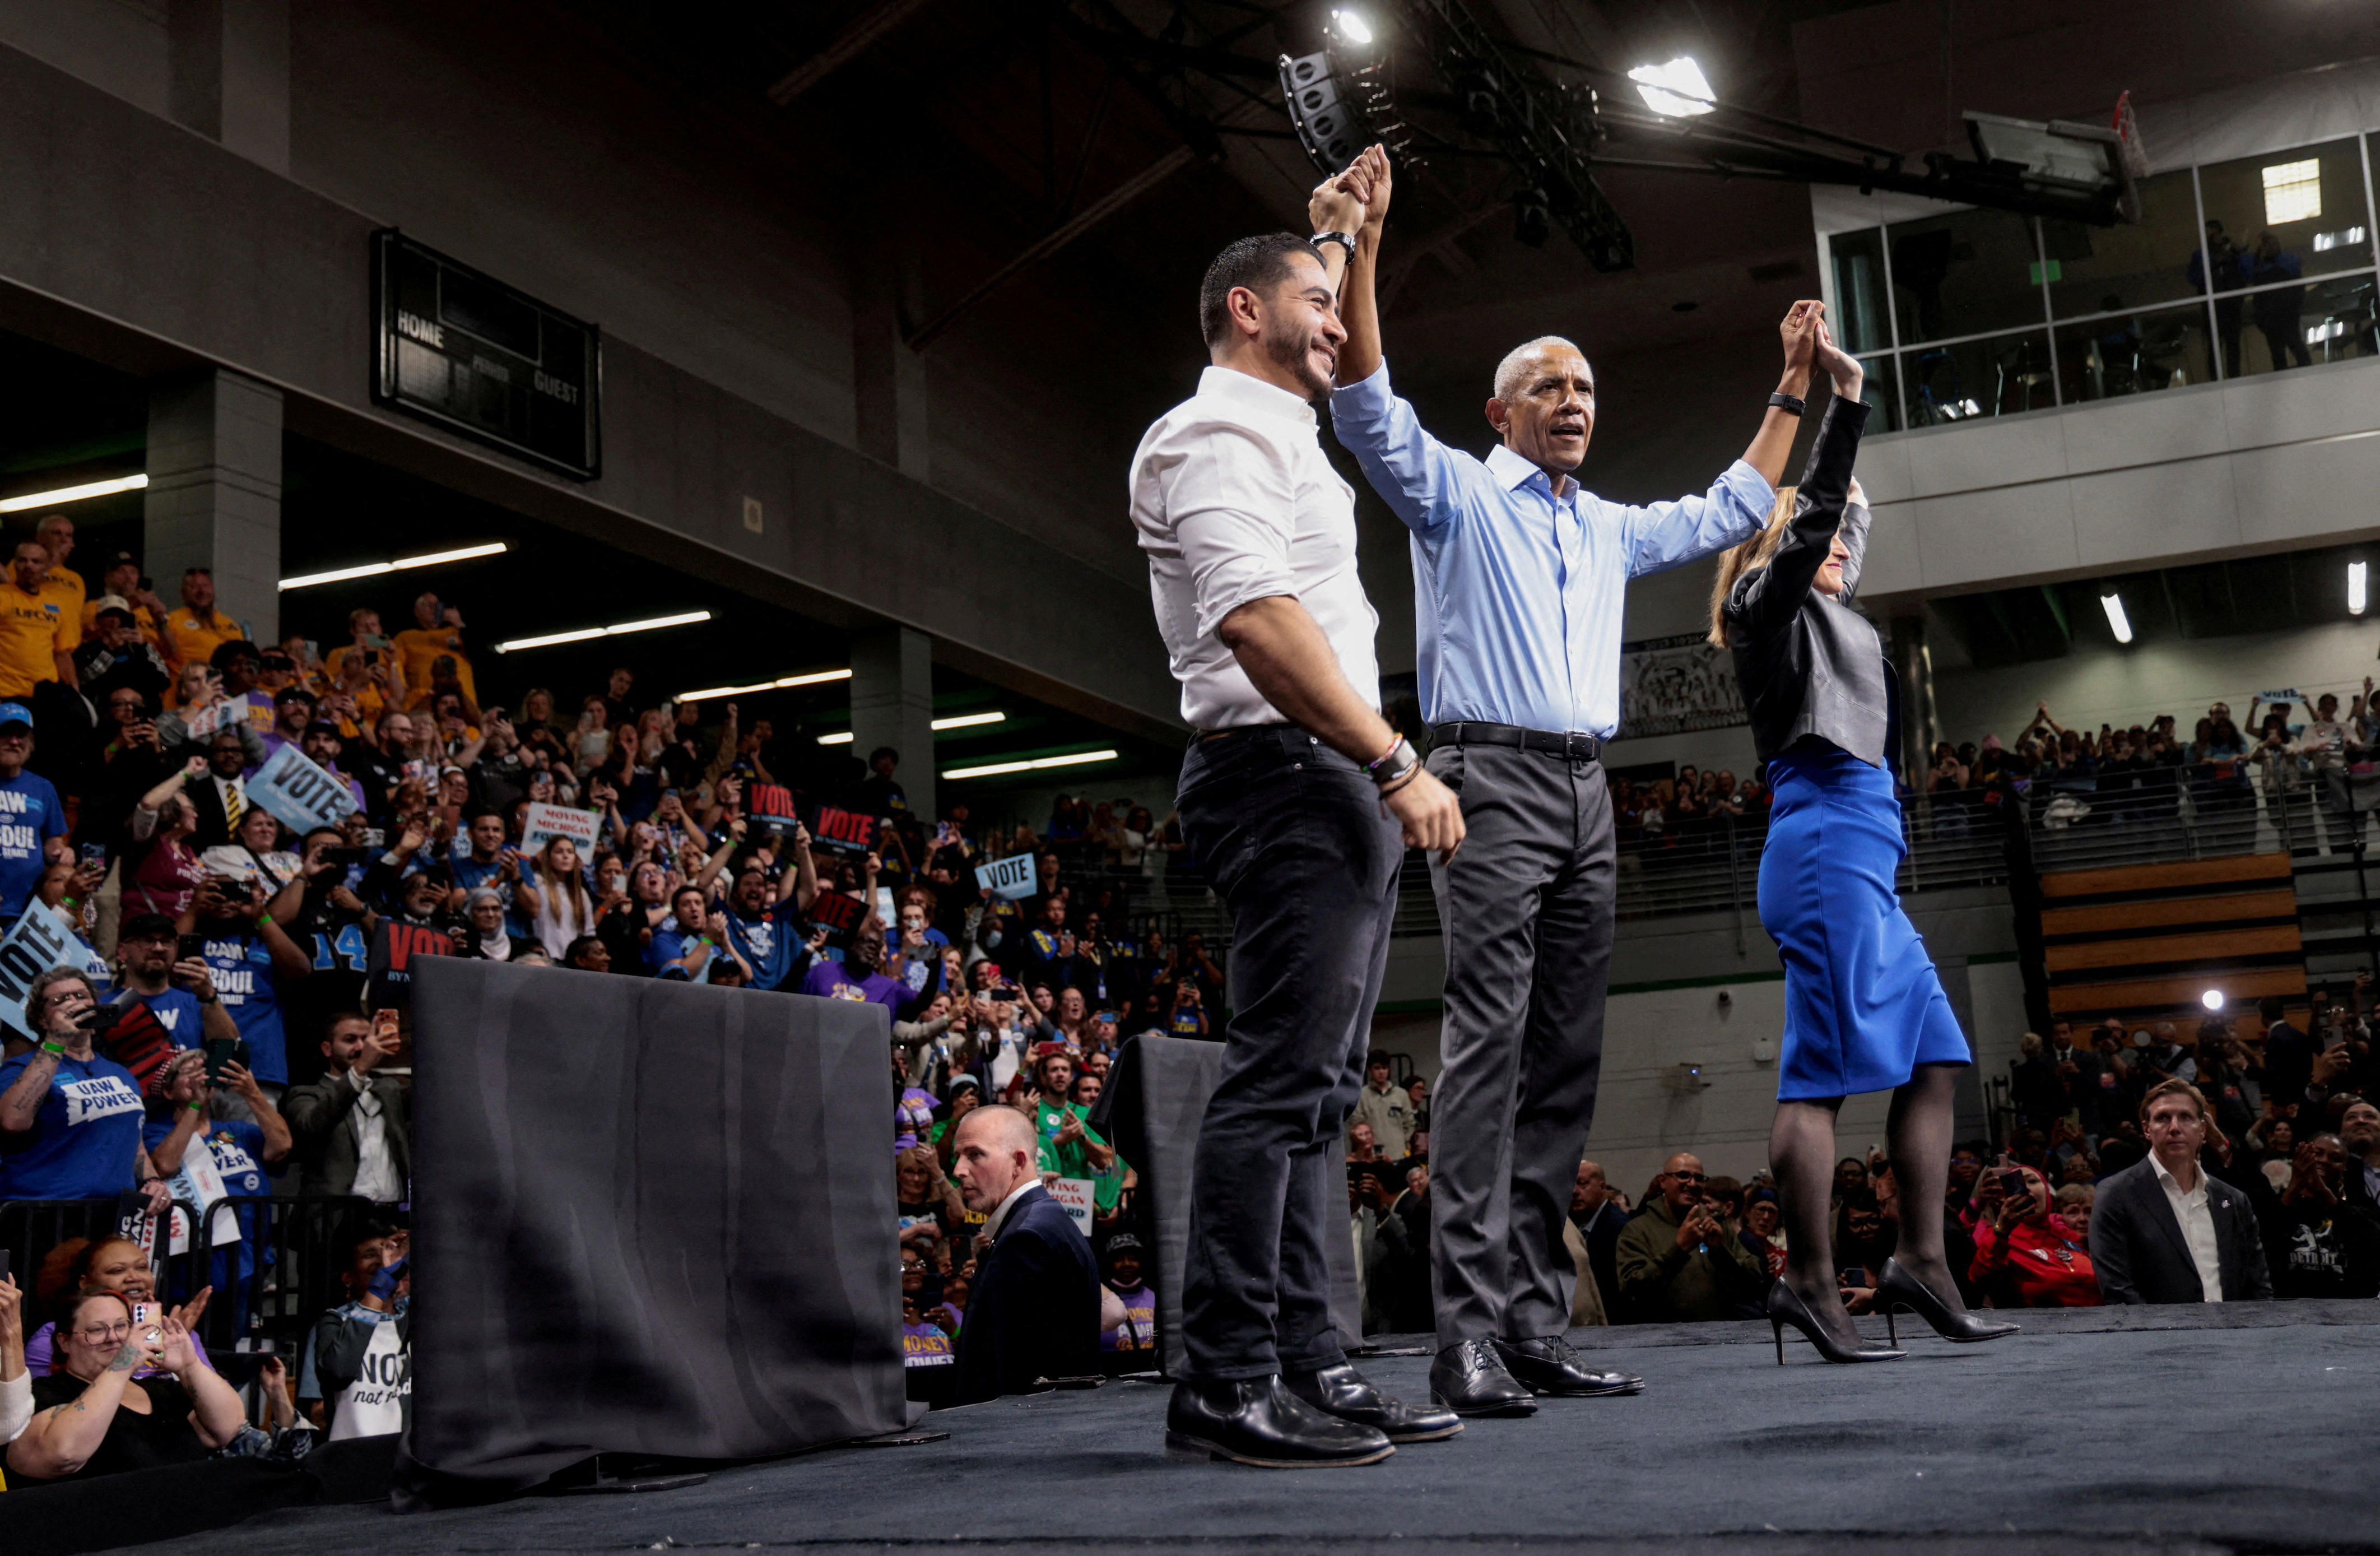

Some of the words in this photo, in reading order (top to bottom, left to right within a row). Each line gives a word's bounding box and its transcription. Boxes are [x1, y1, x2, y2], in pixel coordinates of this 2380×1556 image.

[398, 309, 444, 350] HOME
[534, 369, 578, 406] GUEST
[273, 755, 347, 821] VOTE
[751, 783, 797, 819] VOTE
[536, 819, 591, 835] MICHIGAN
[546, 809, 589, 824] MOVING
[817, 806, 875, 845] VOTE
[985, 859, 1028, 888] VOTE
[311, 925, 368, 973] 14
[208, 968, 255, 994] BDUL
[77, 1080, 115, 1095] UAW
[81, 1093, 141, 1114] POWER
[2290, 1252, 2340, 1265] DETROIT
[354, 1391, 383, 1405] not
